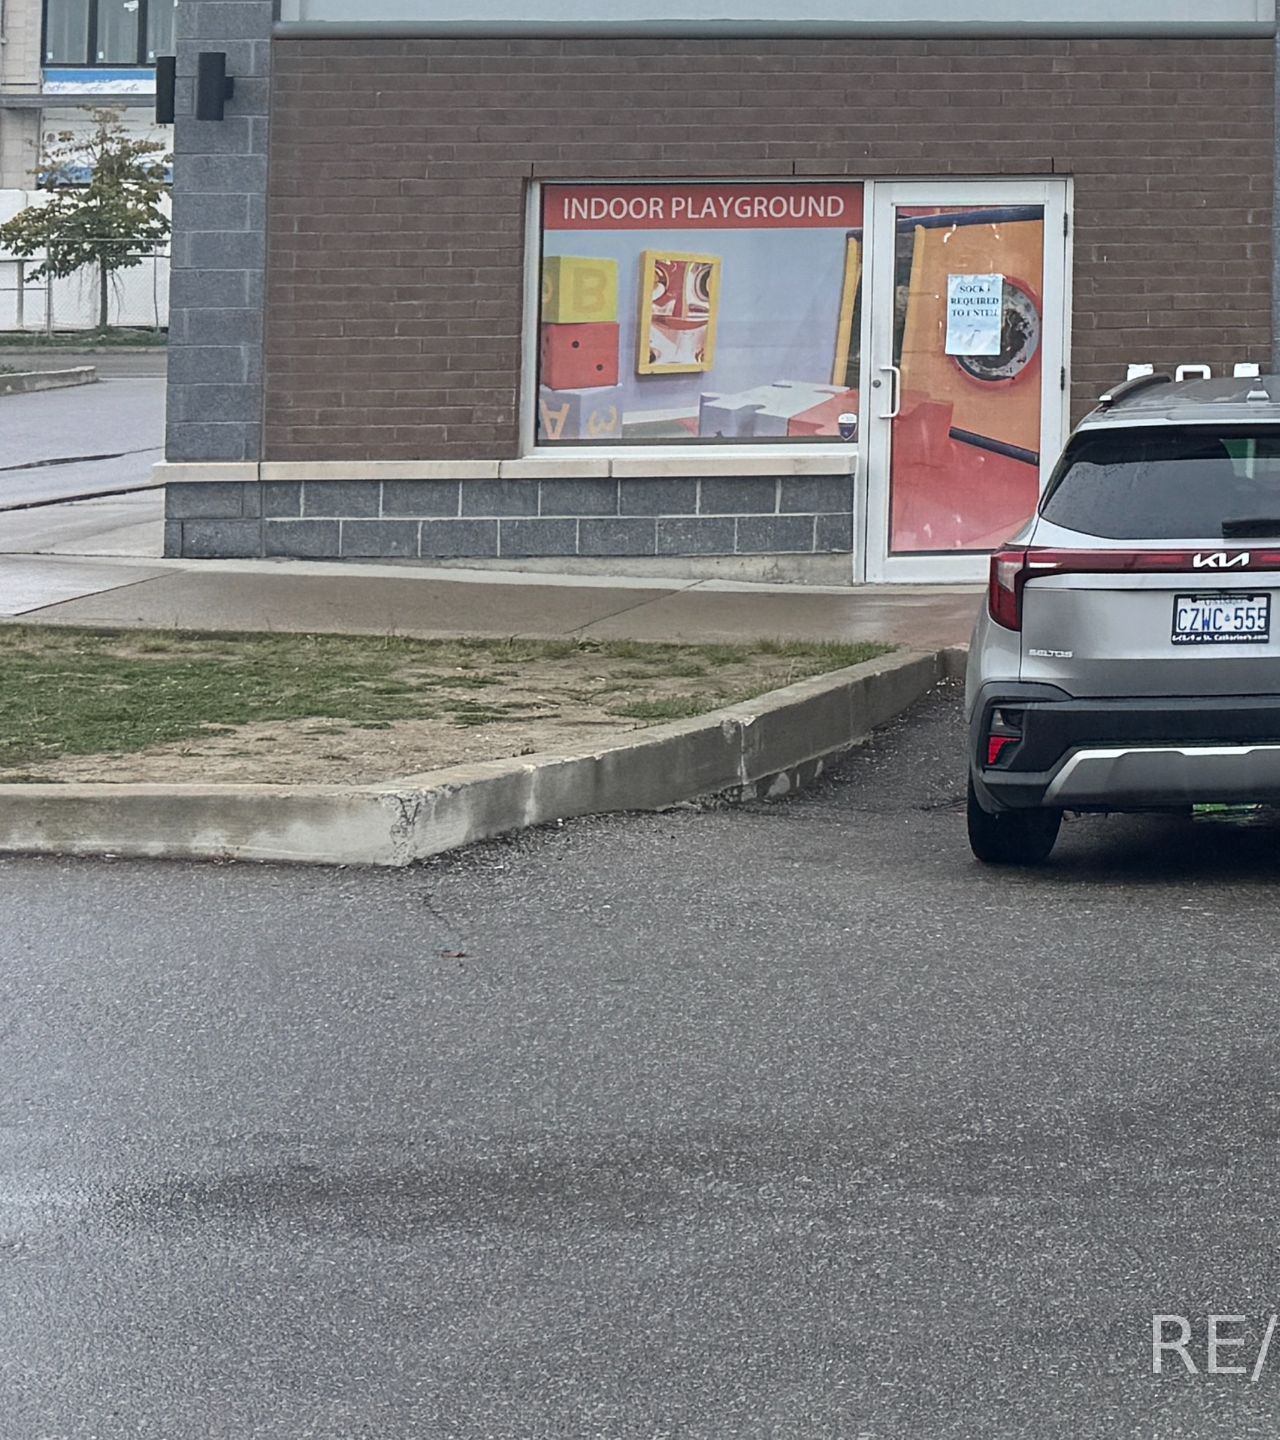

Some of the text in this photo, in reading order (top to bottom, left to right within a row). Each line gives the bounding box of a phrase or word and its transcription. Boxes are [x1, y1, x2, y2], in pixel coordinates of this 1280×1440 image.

[563, 195, 845, 220] INDOOR PLAYGROUND
[1192, 552, 1250, 568] KIA
[1178, 607, 1267, 631] CZWC 555
